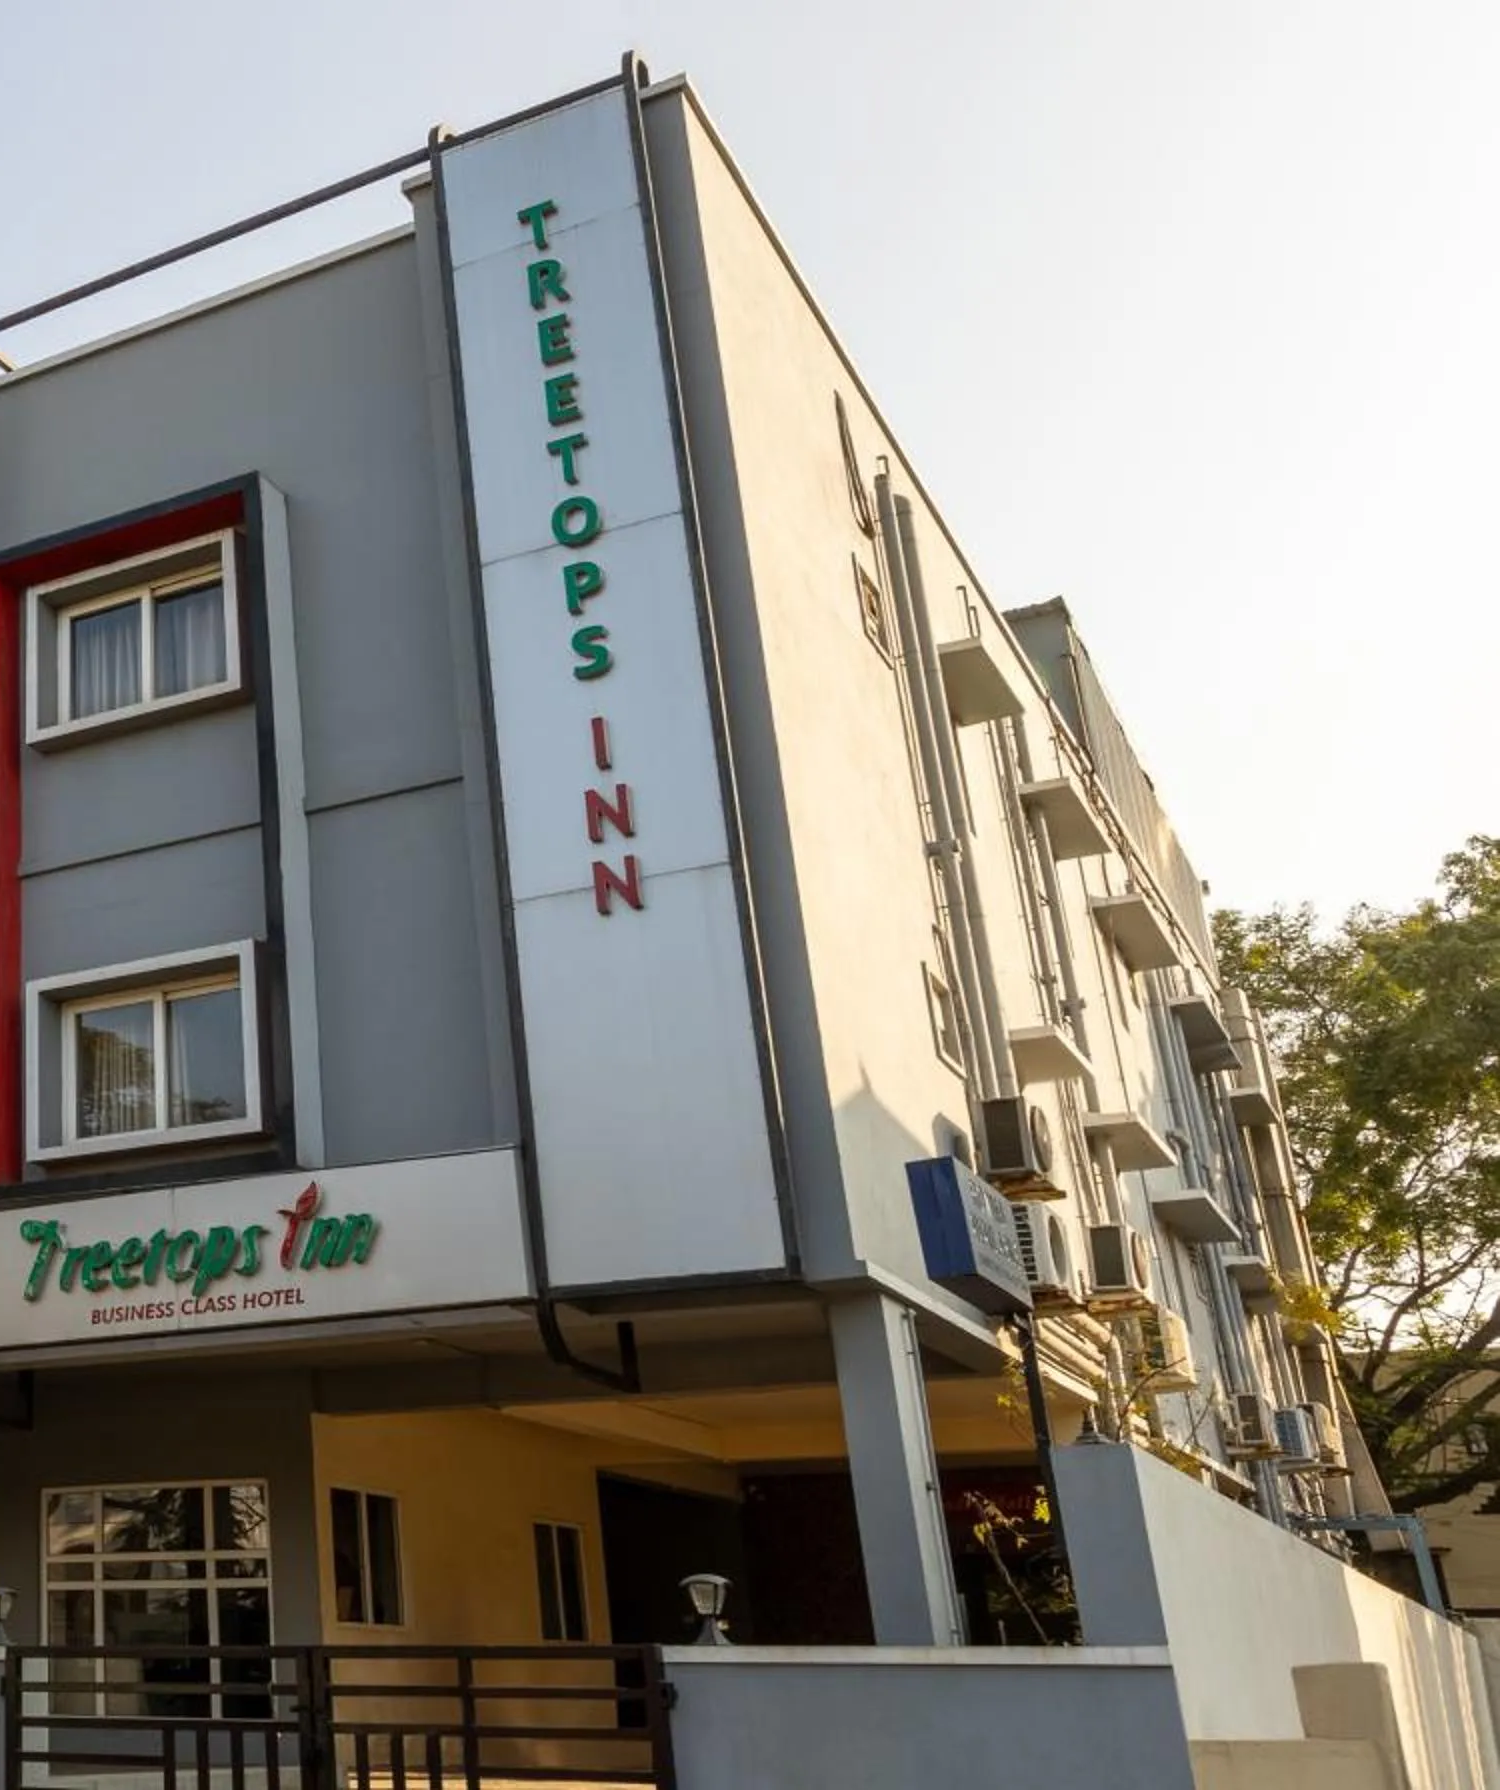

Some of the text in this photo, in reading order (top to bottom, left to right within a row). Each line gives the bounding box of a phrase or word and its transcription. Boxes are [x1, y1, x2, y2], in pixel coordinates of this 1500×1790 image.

[518, 200, 642, 915] TREETOPS INN
[20, 1219, 270, 1301] Treetops
[92, 1288, 305, 1324] BUSINESS CLASS HOTEL
